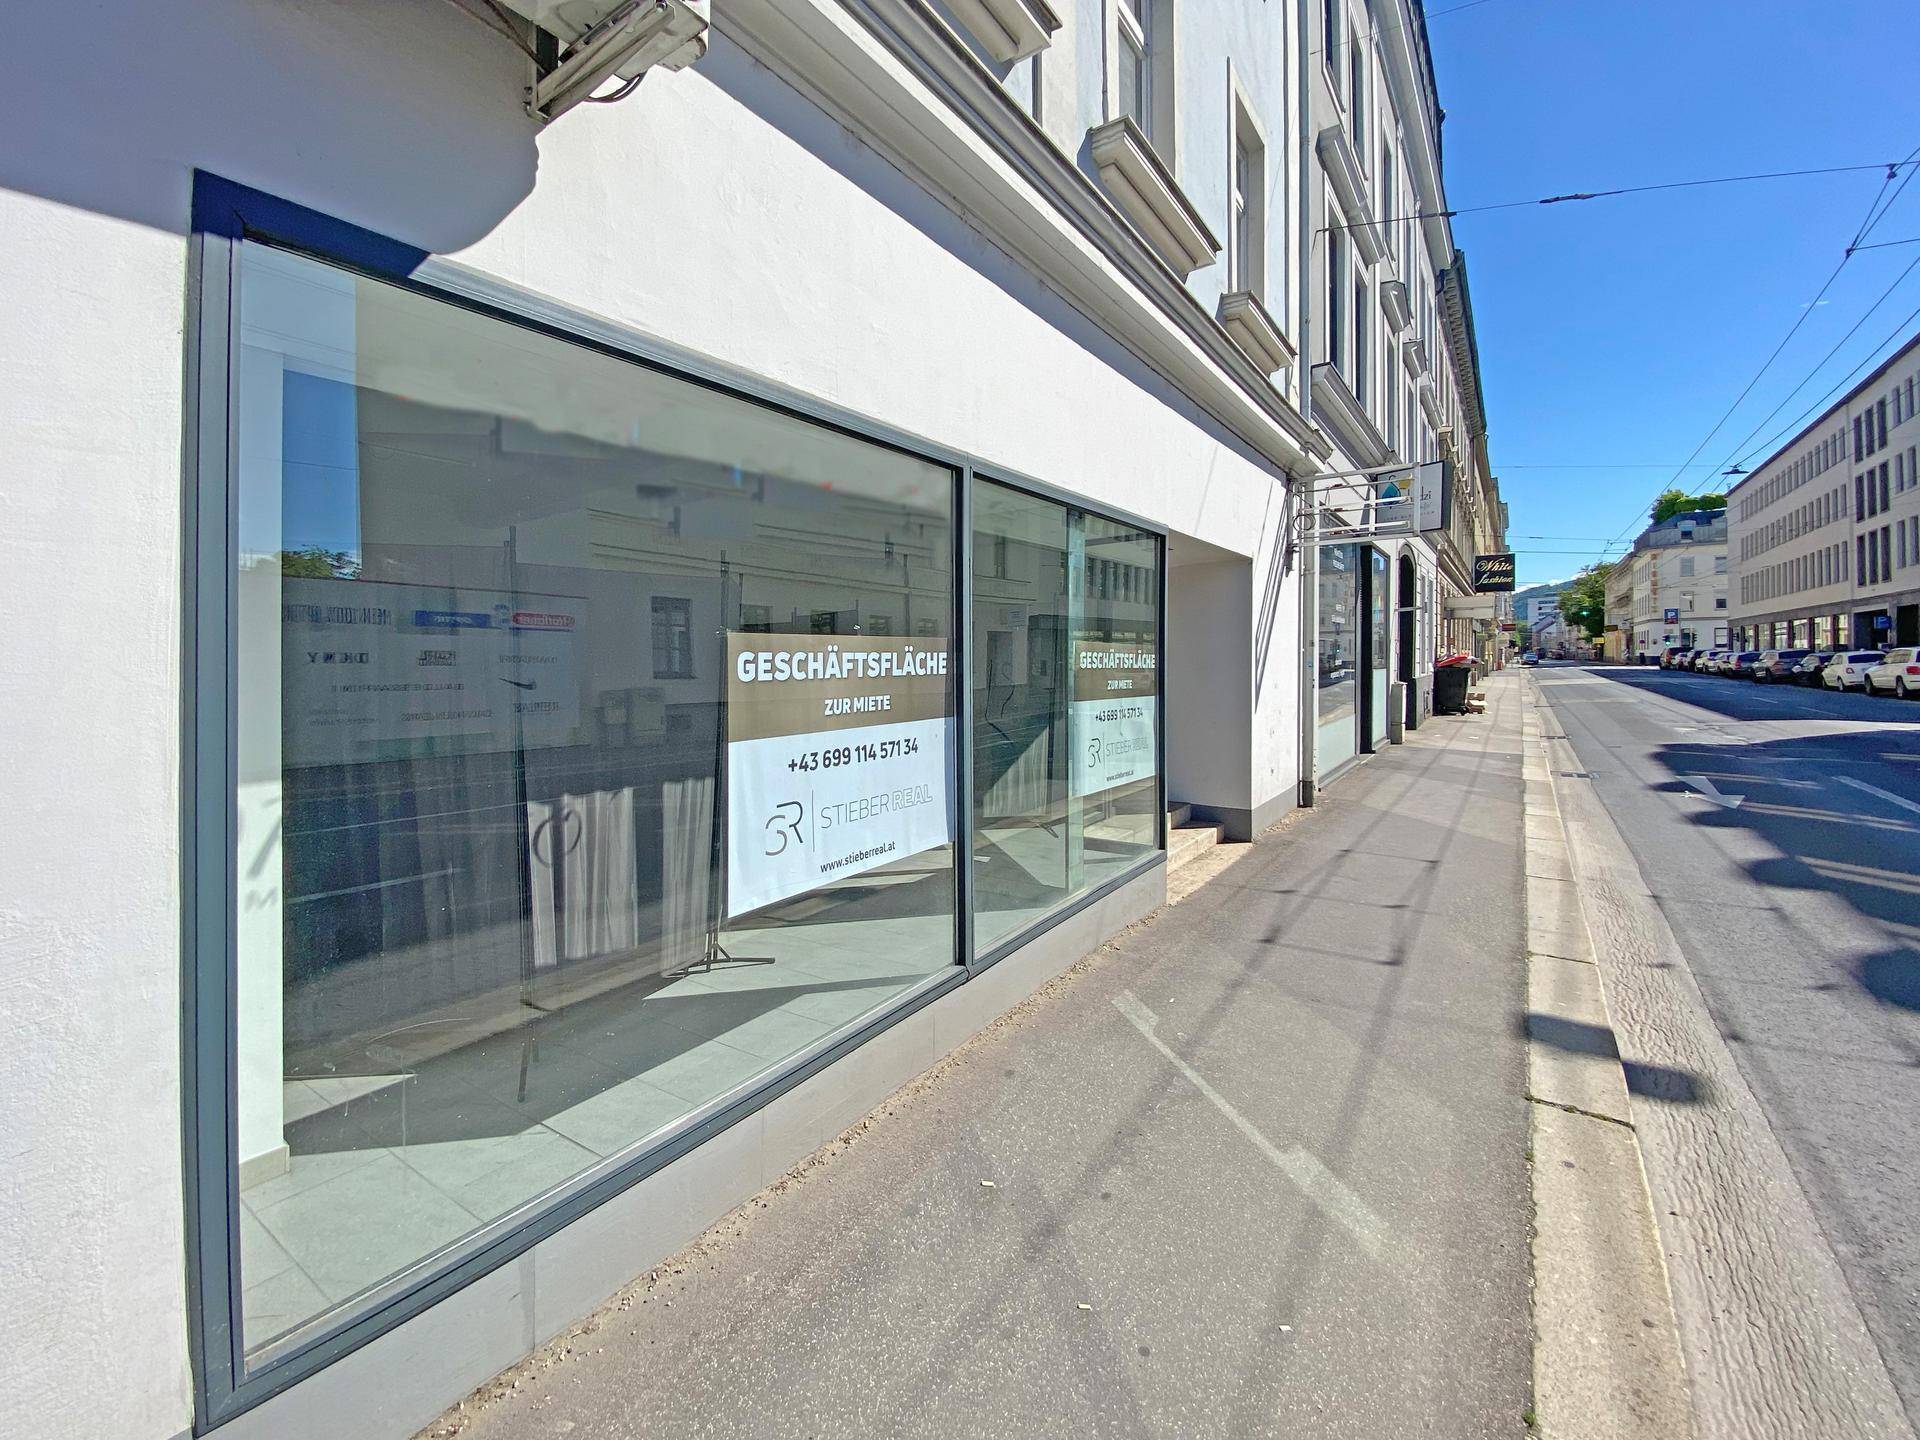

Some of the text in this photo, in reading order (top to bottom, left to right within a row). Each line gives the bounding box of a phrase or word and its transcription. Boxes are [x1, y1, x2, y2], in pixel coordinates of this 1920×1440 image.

[1476, 557, 1513, 572] White
[1667, 611, 1676, 619] P
[737, 644, 948, 683] GESCHÄFTSFLÄCHE
[1079, 649, 1156, 669] GESCHÄFTSFLÄCHE
[824, 694, 891, 716] ZUR MIETE
[1095, 711, 1106, 722] +43
[1106, 709, 1118, 721] 699
[788, 751, 819, 773] +43
[822, 748, 851, 769] 699
[854, 744, 877, 765] 114
[820, 793, 890, 829] STIEBER
[892, 784, 934, 811] REAL
[820, 841, 896, 873] www.stieberreal.at
